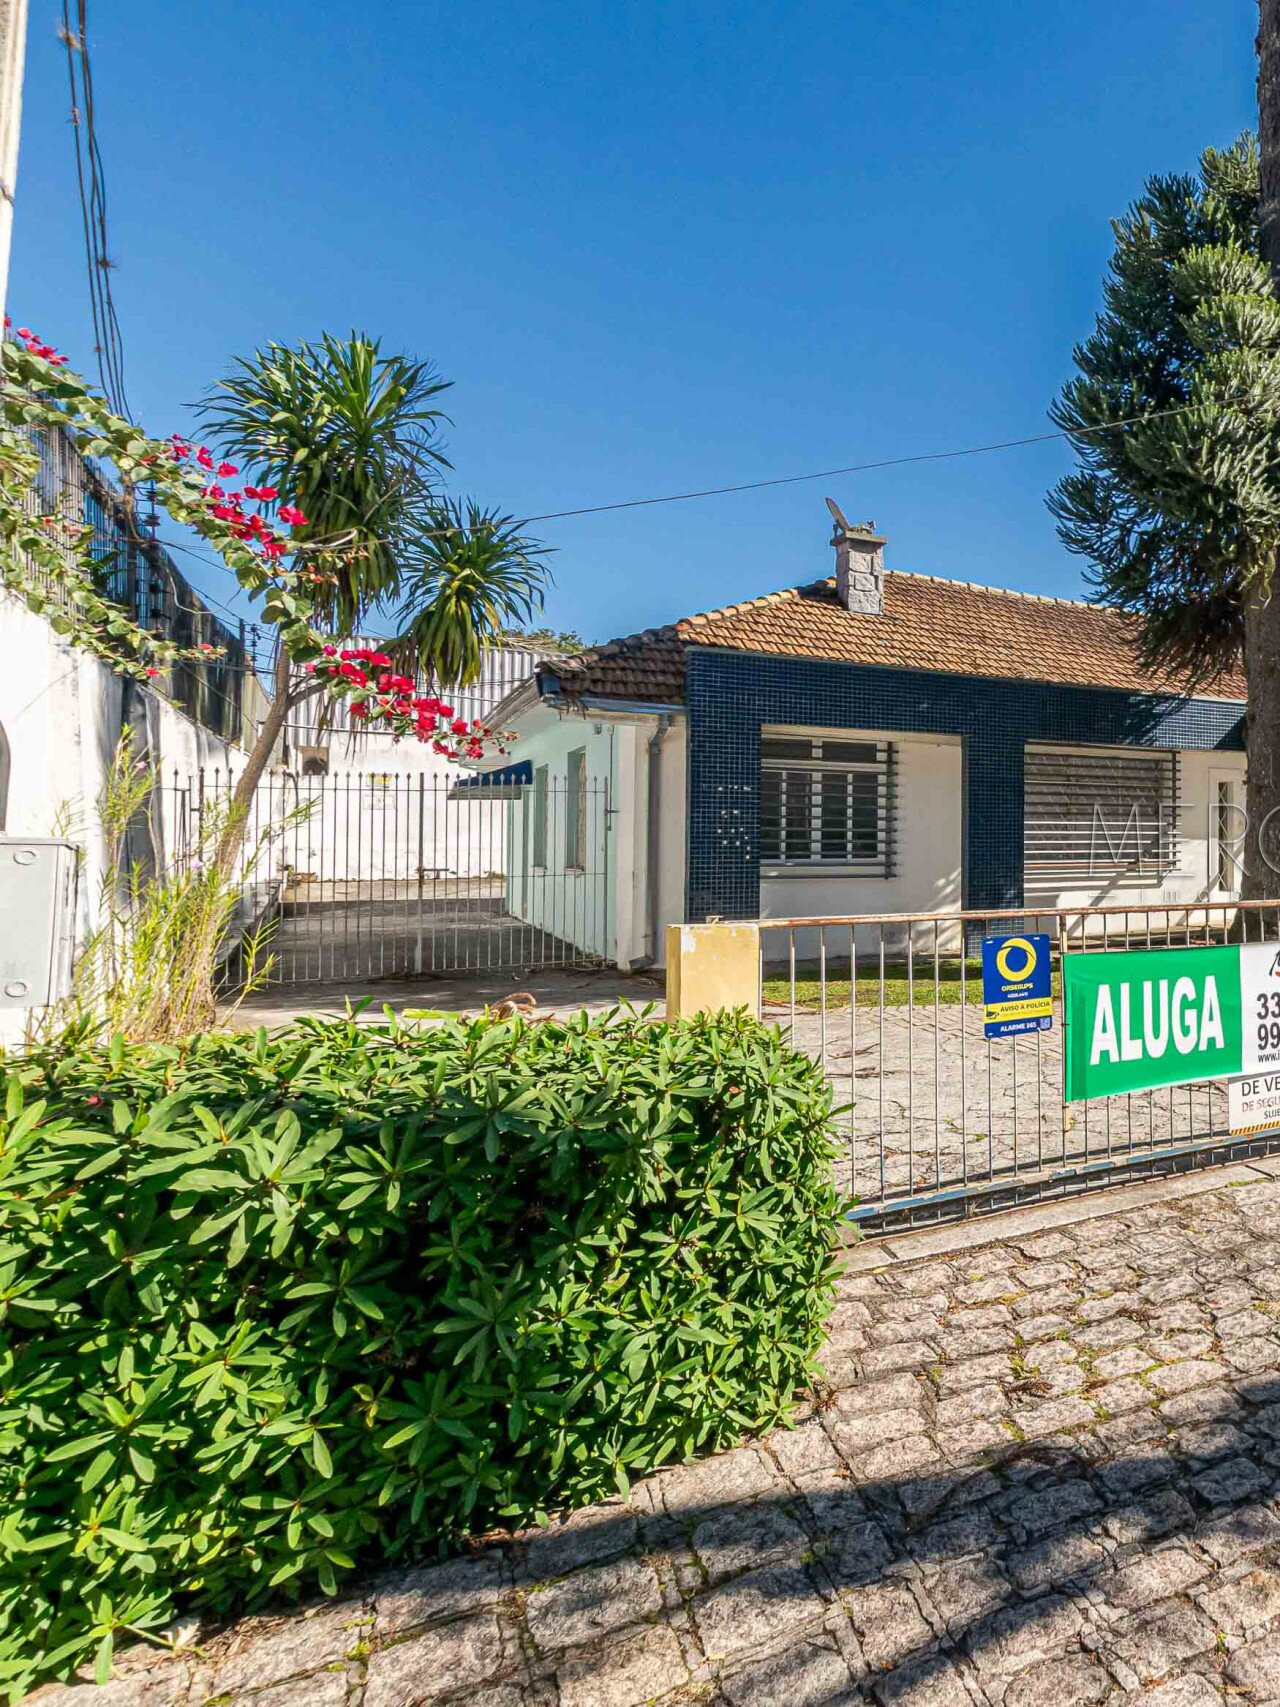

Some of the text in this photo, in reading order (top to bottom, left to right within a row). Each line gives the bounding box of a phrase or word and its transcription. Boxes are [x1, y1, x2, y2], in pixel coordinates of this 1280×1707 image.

[1001, 982, 1034, 991] ORSEGUPS
[1000, 1004, 1019, 1012] AVISO
[1090, 975, 1225, 1066] ALUGA
[1000, 1023, 1025, 1032] ALARME
[1241, 1080, 1260, 1097] DE
[1242, 1102, 1254, 1112] DE
